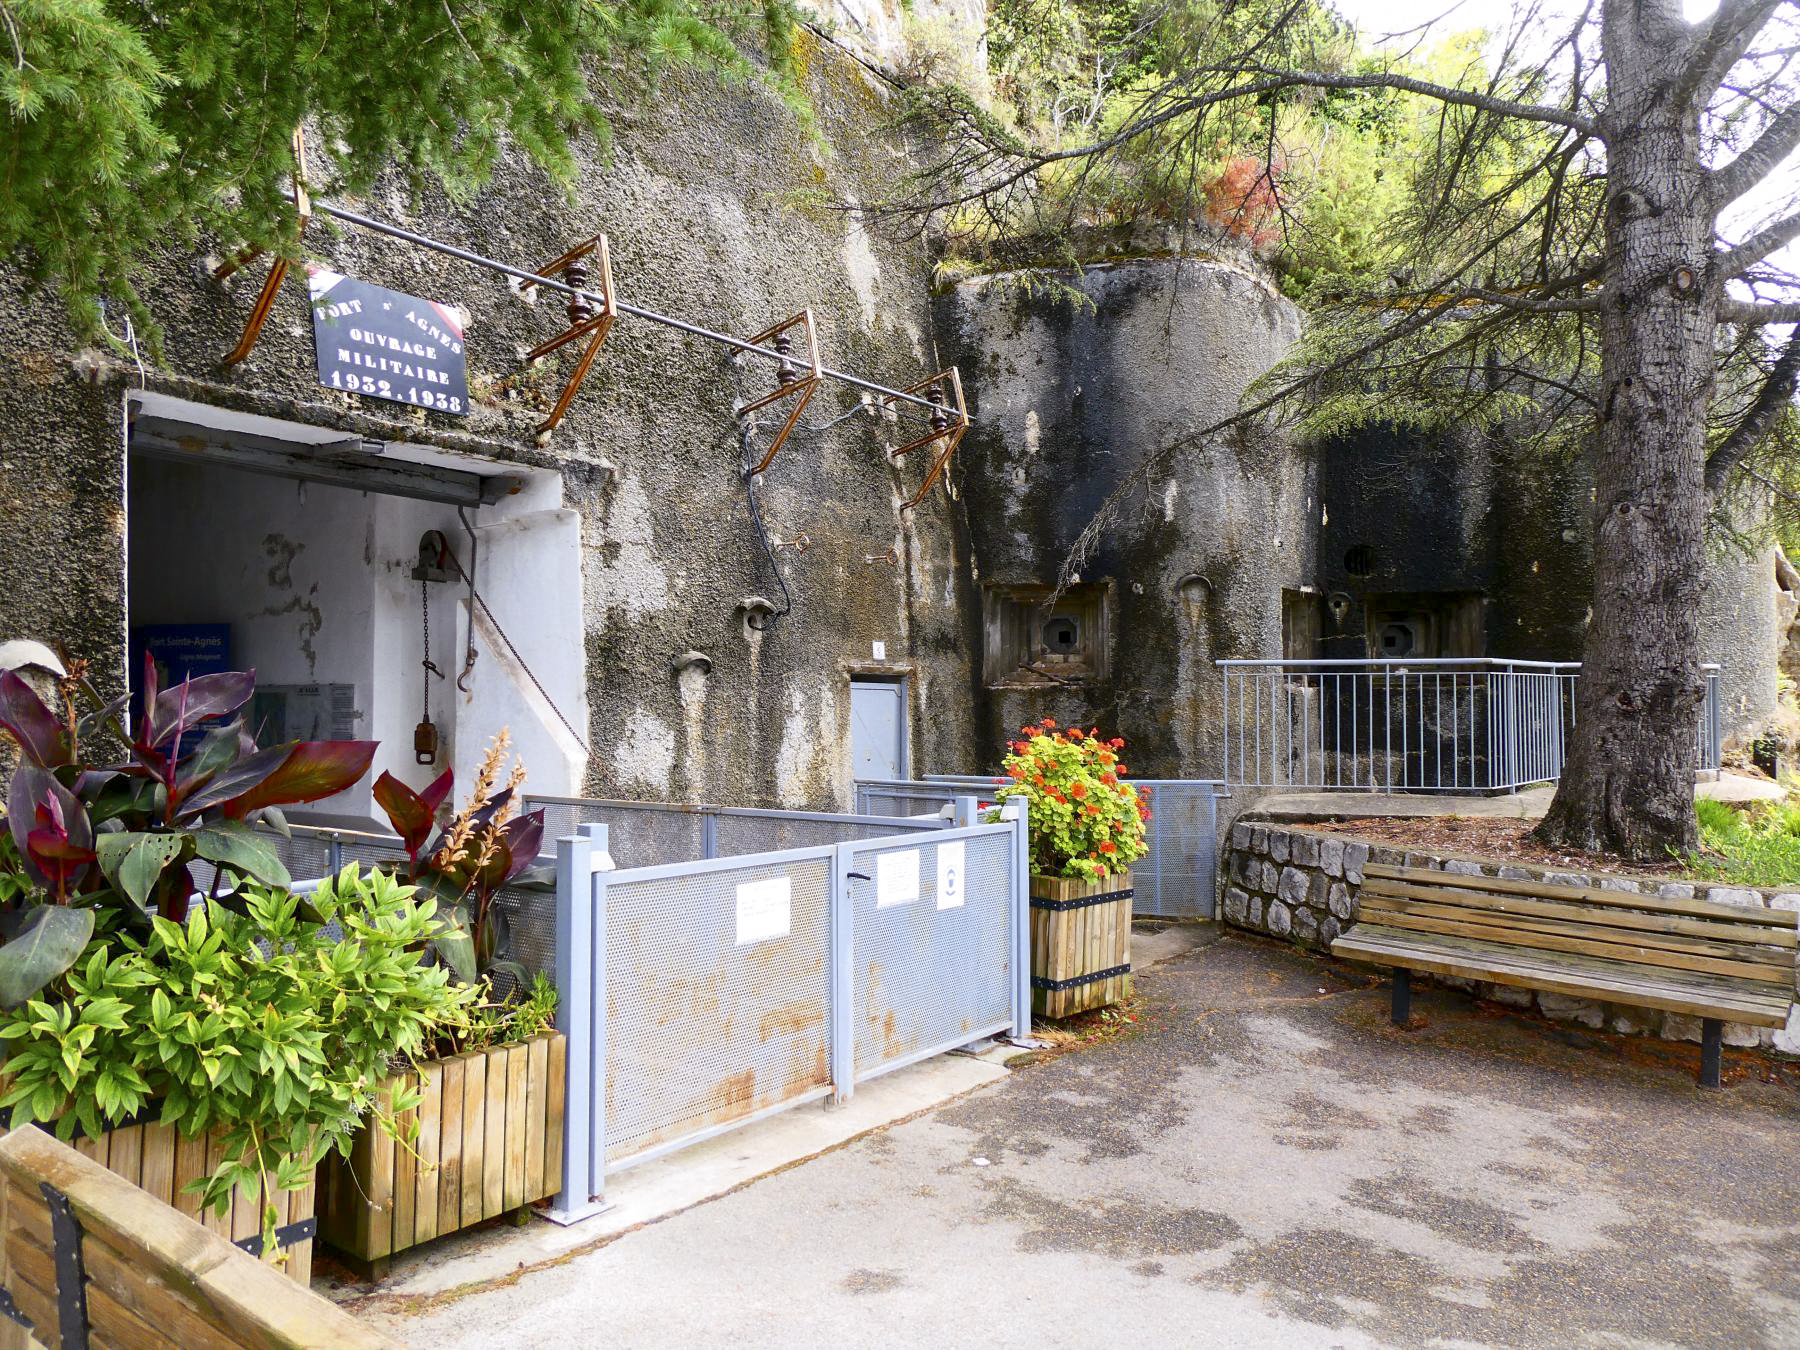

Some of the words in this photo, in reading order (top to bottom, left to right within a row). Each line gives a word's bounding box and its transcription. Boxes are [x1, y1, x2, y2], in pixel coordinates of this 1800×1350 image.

[317, 299, 362, 320] FORT
[405, 311, 461, 354] AGNES
[350, 328, 437, 360] OUVRAGE
[338, 348, 449, 385] MILITAIRE
